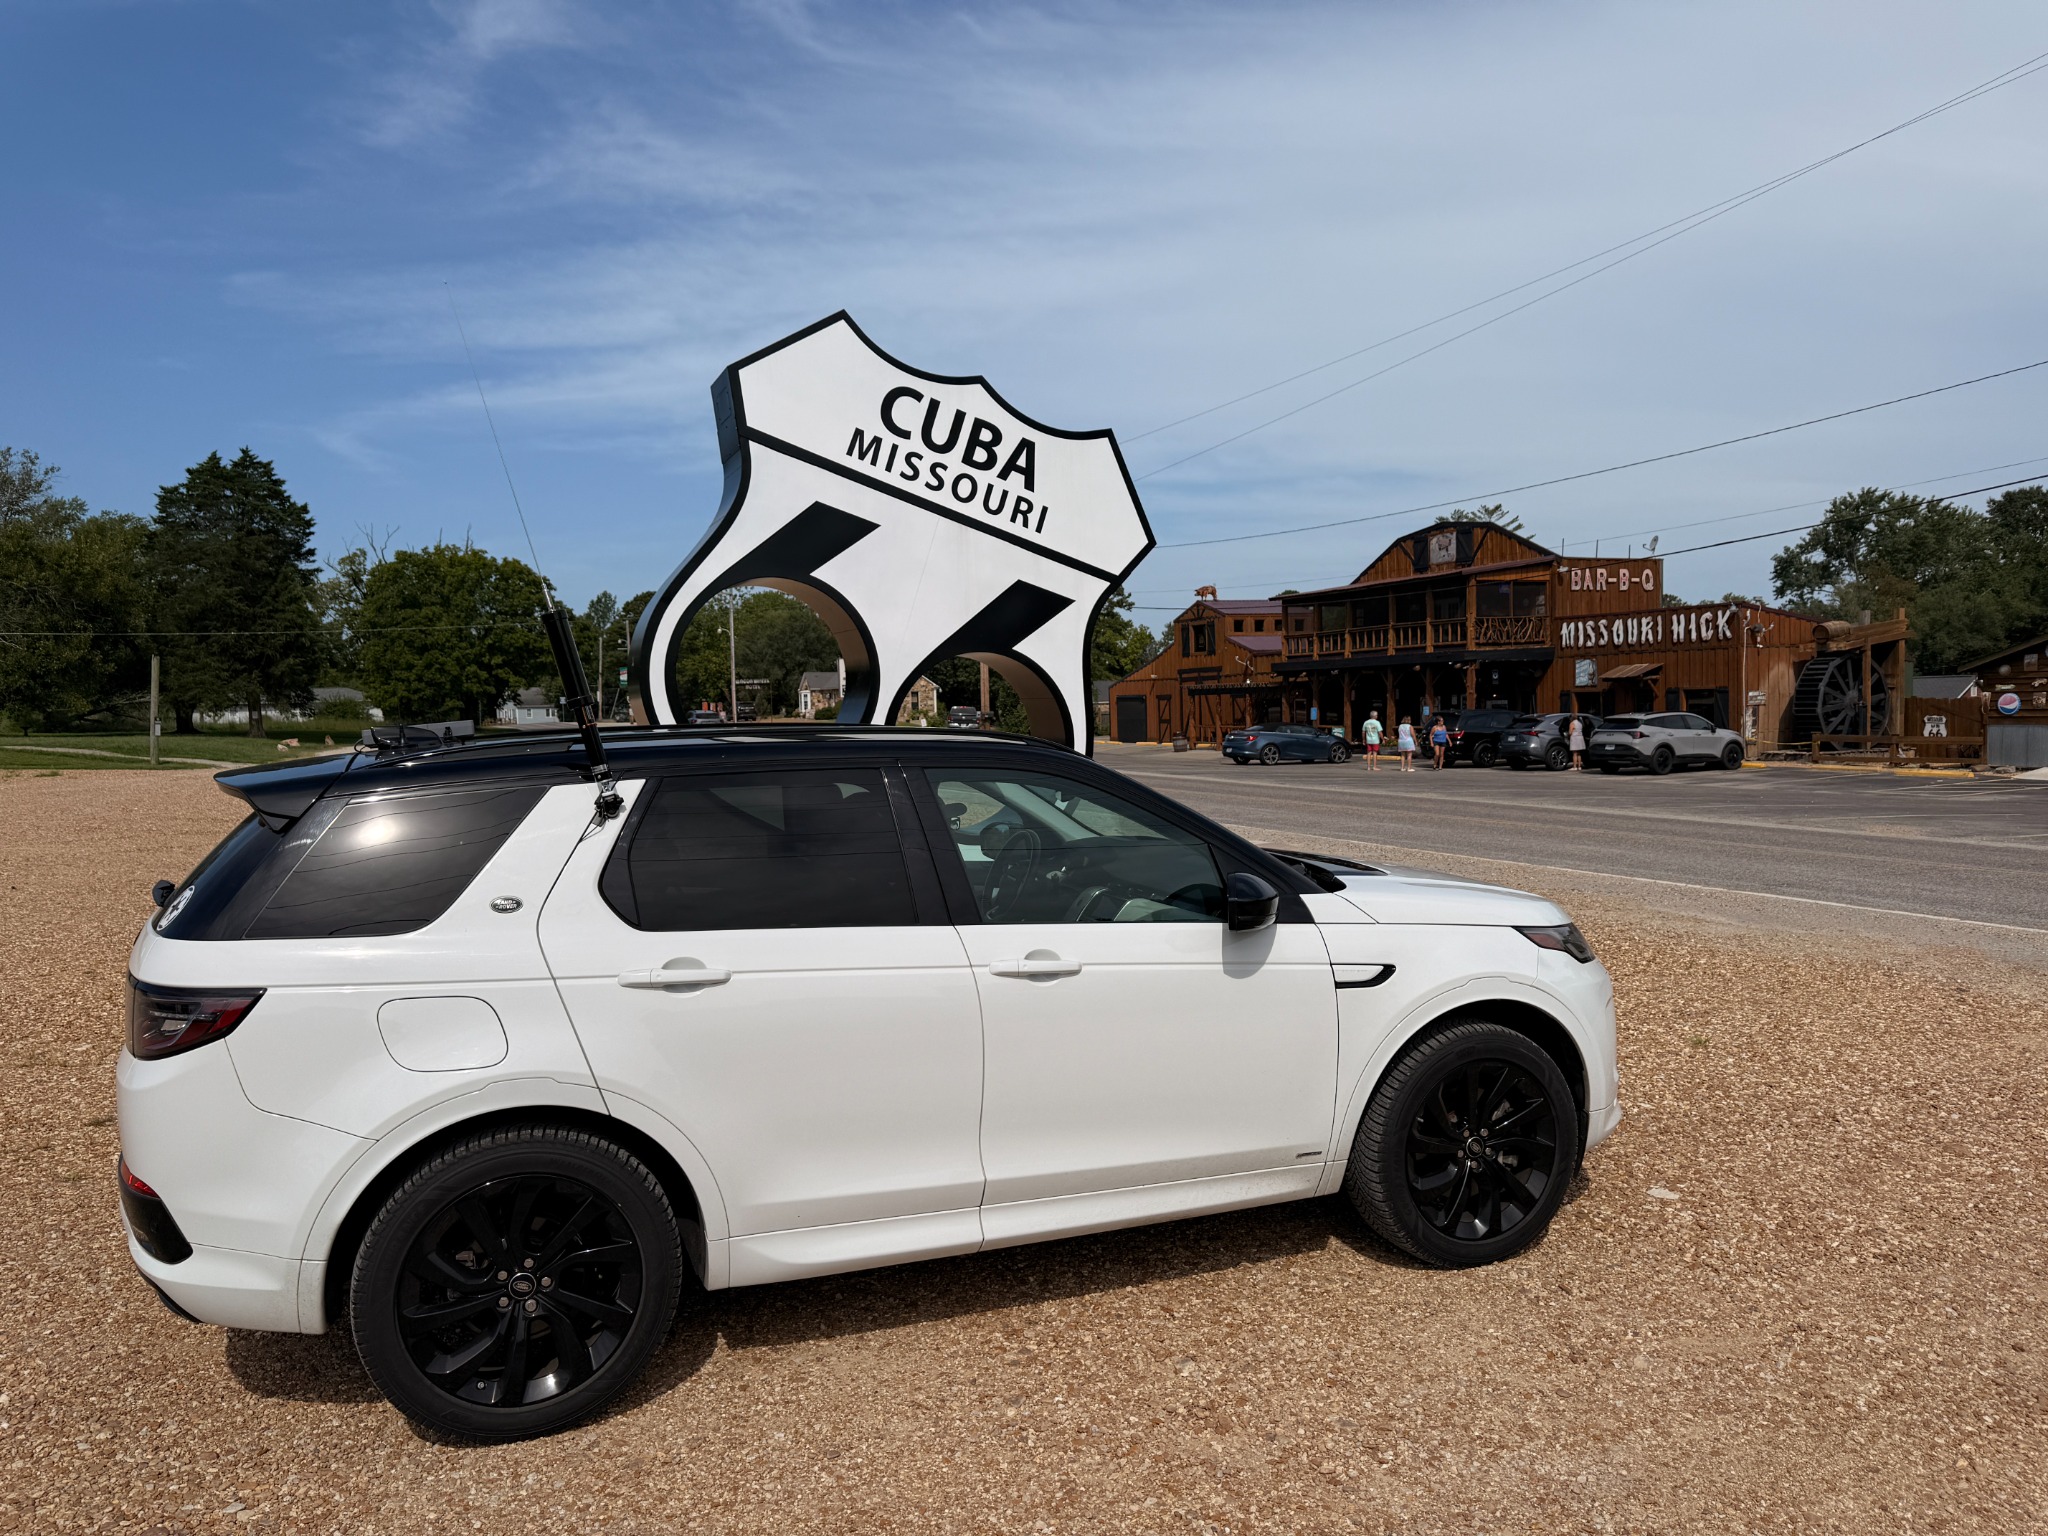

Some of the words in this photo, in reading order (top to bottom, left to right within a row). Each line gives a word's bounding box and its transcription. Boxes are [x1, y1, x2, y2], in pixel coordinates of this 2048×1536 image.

[880, 386, 1036, 493] CUBA
[845, 427, 1049, 534] MISSOURI
[1570, 568, 1655, 591] BAR-B-Q
[1560, 614, 1663, 648] MISSOURI
[1671, 609, 1733, 643] HICK
[1928, 728, 1942, 736] 66
